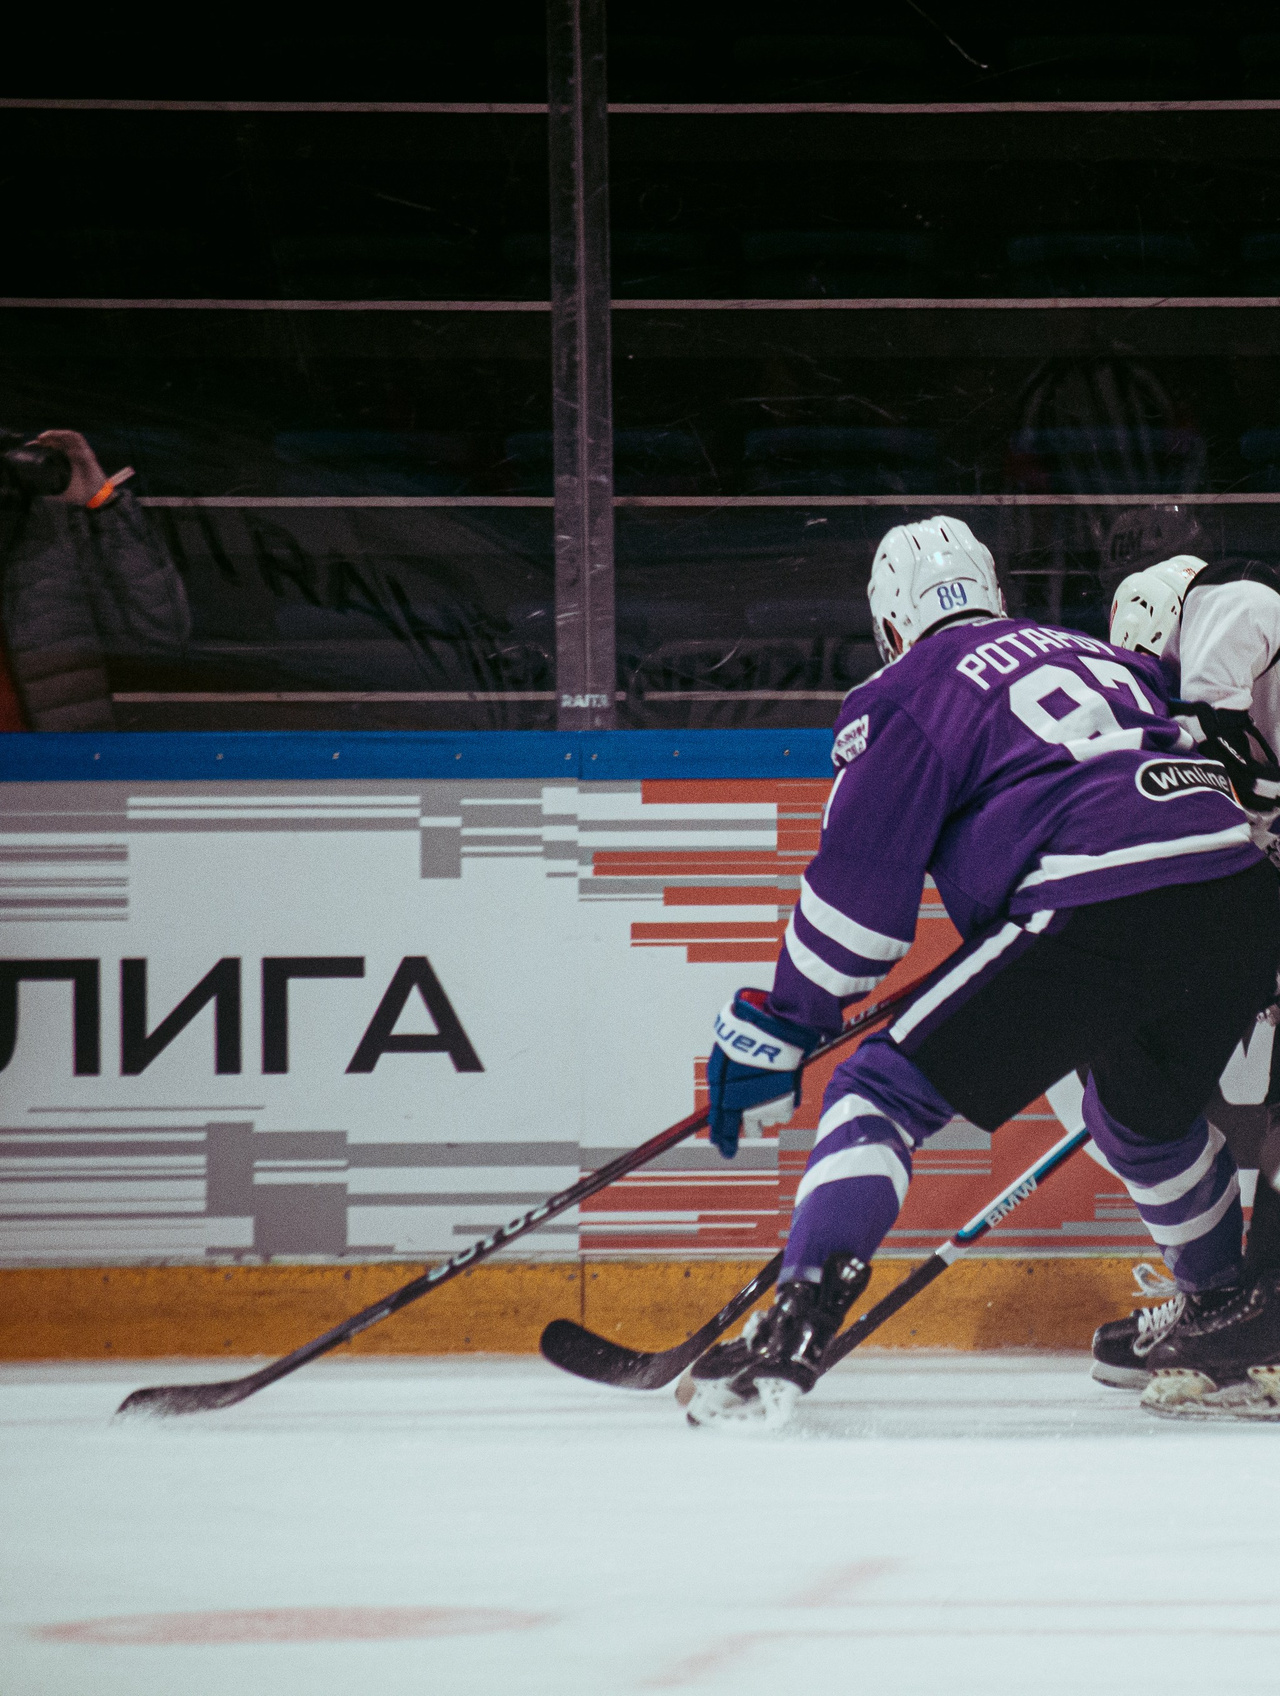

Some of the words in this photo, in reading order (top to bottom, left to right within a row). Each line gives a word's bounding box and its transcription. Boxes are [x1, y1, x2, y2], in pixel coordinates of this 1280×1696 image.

[936, 581, 968, 611] 89
[1148, 765, 1231, 793] Winline
[0, 955, 486, 1077] ЛИГА
[984, 1175, 1038, 1229] BMW
